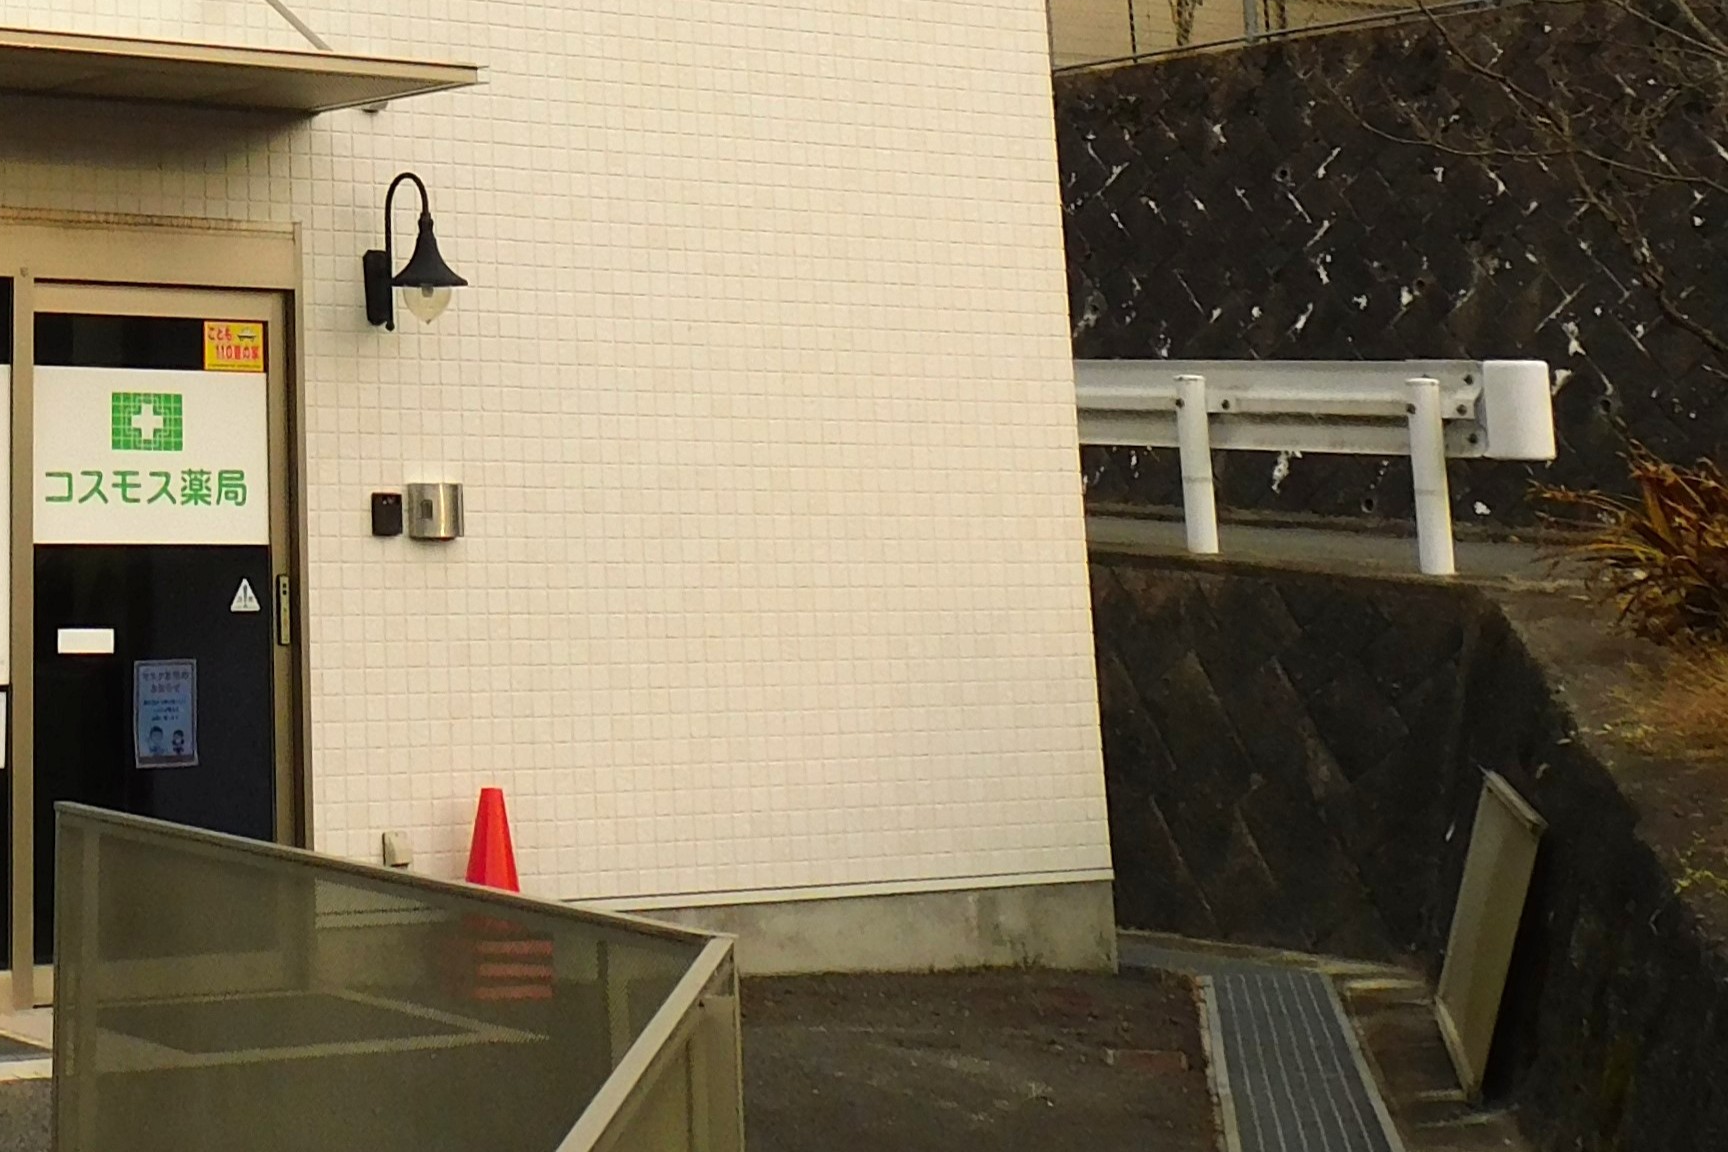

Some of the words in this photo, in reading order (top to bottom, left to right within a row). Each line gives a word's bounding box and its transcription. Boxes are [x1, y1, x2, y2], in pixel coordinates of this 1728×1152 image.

[44, 468, 247, 507] コスモス薬局
